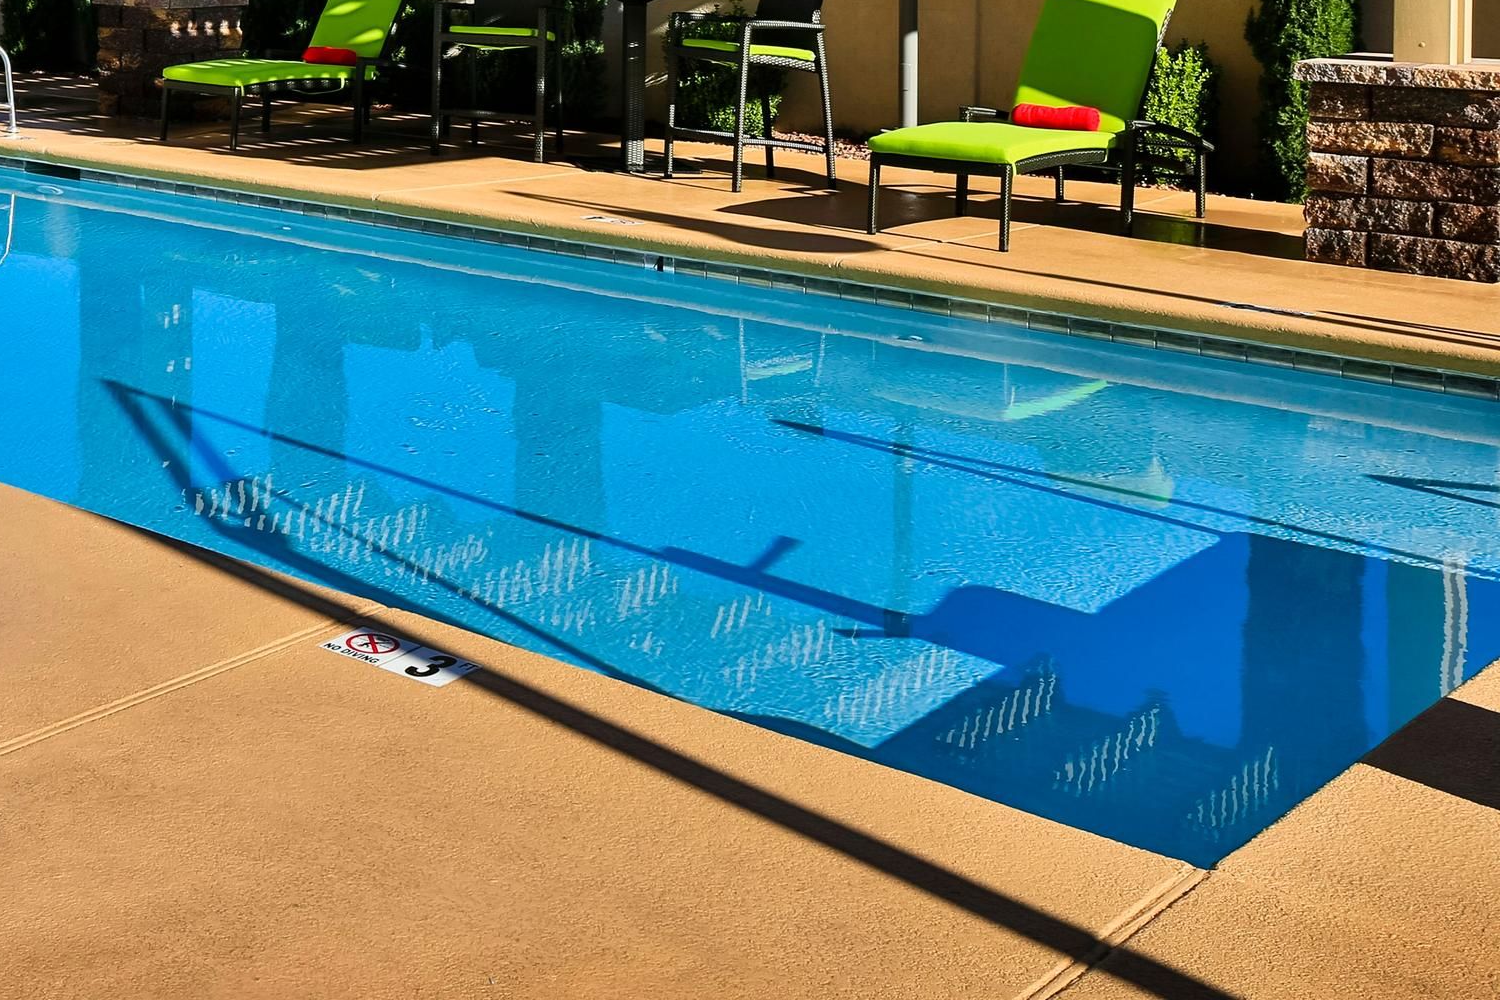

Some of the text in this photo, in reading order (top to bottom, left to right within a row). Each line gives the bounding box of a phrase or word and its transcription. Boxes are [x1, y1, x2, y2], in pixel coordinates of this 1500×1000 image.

[324, 642, 380, 664] NO DIVING
[404, 655, 458, 678] 3
